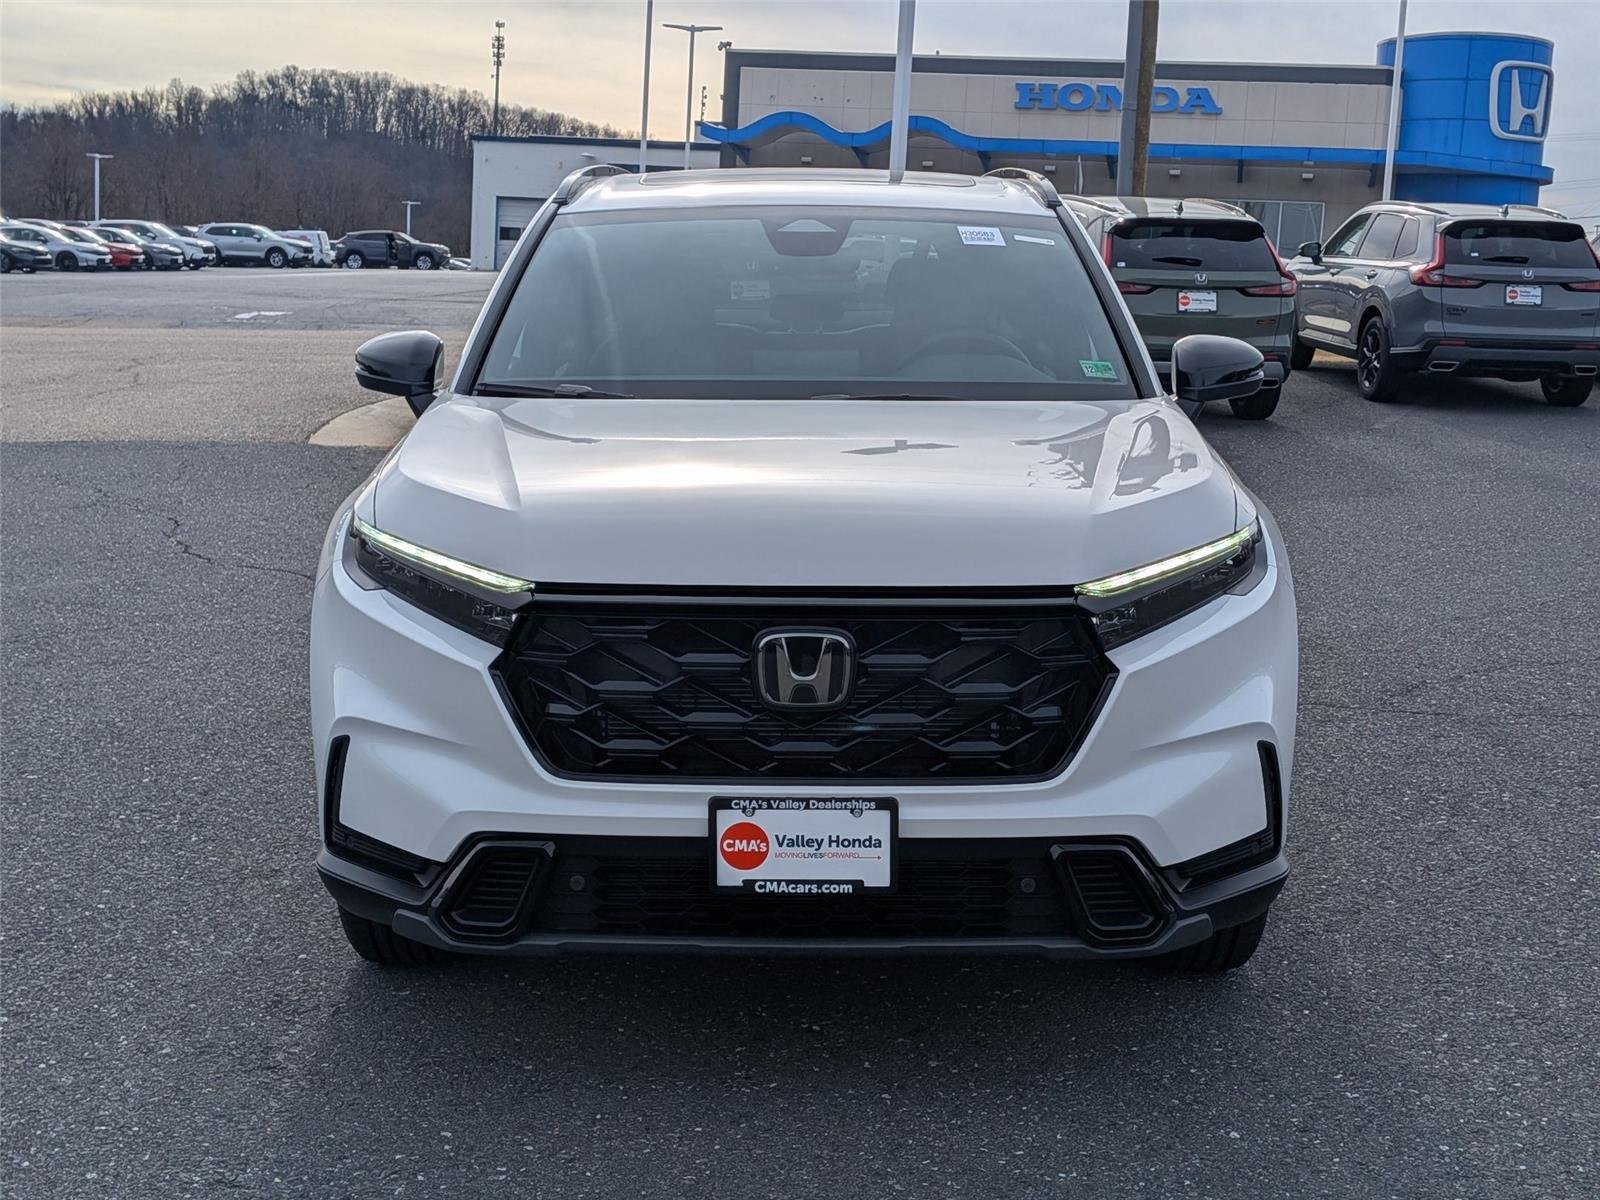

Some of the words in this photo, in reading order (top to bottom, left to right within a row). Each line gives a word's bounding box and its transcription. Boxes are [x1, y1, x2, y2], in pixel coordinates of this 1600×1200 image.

[731, 799, 768, 809] CMA's
[770, 800, 806, 811] Valley
[809, 800, 876, 810] Dealerships
[722, 839, 768, 853] CMA's
[774, 834, 824, 851] Valley
[828, 835, 882, 849] Honda
[754, 881, 853, 894] CMAcars.com
